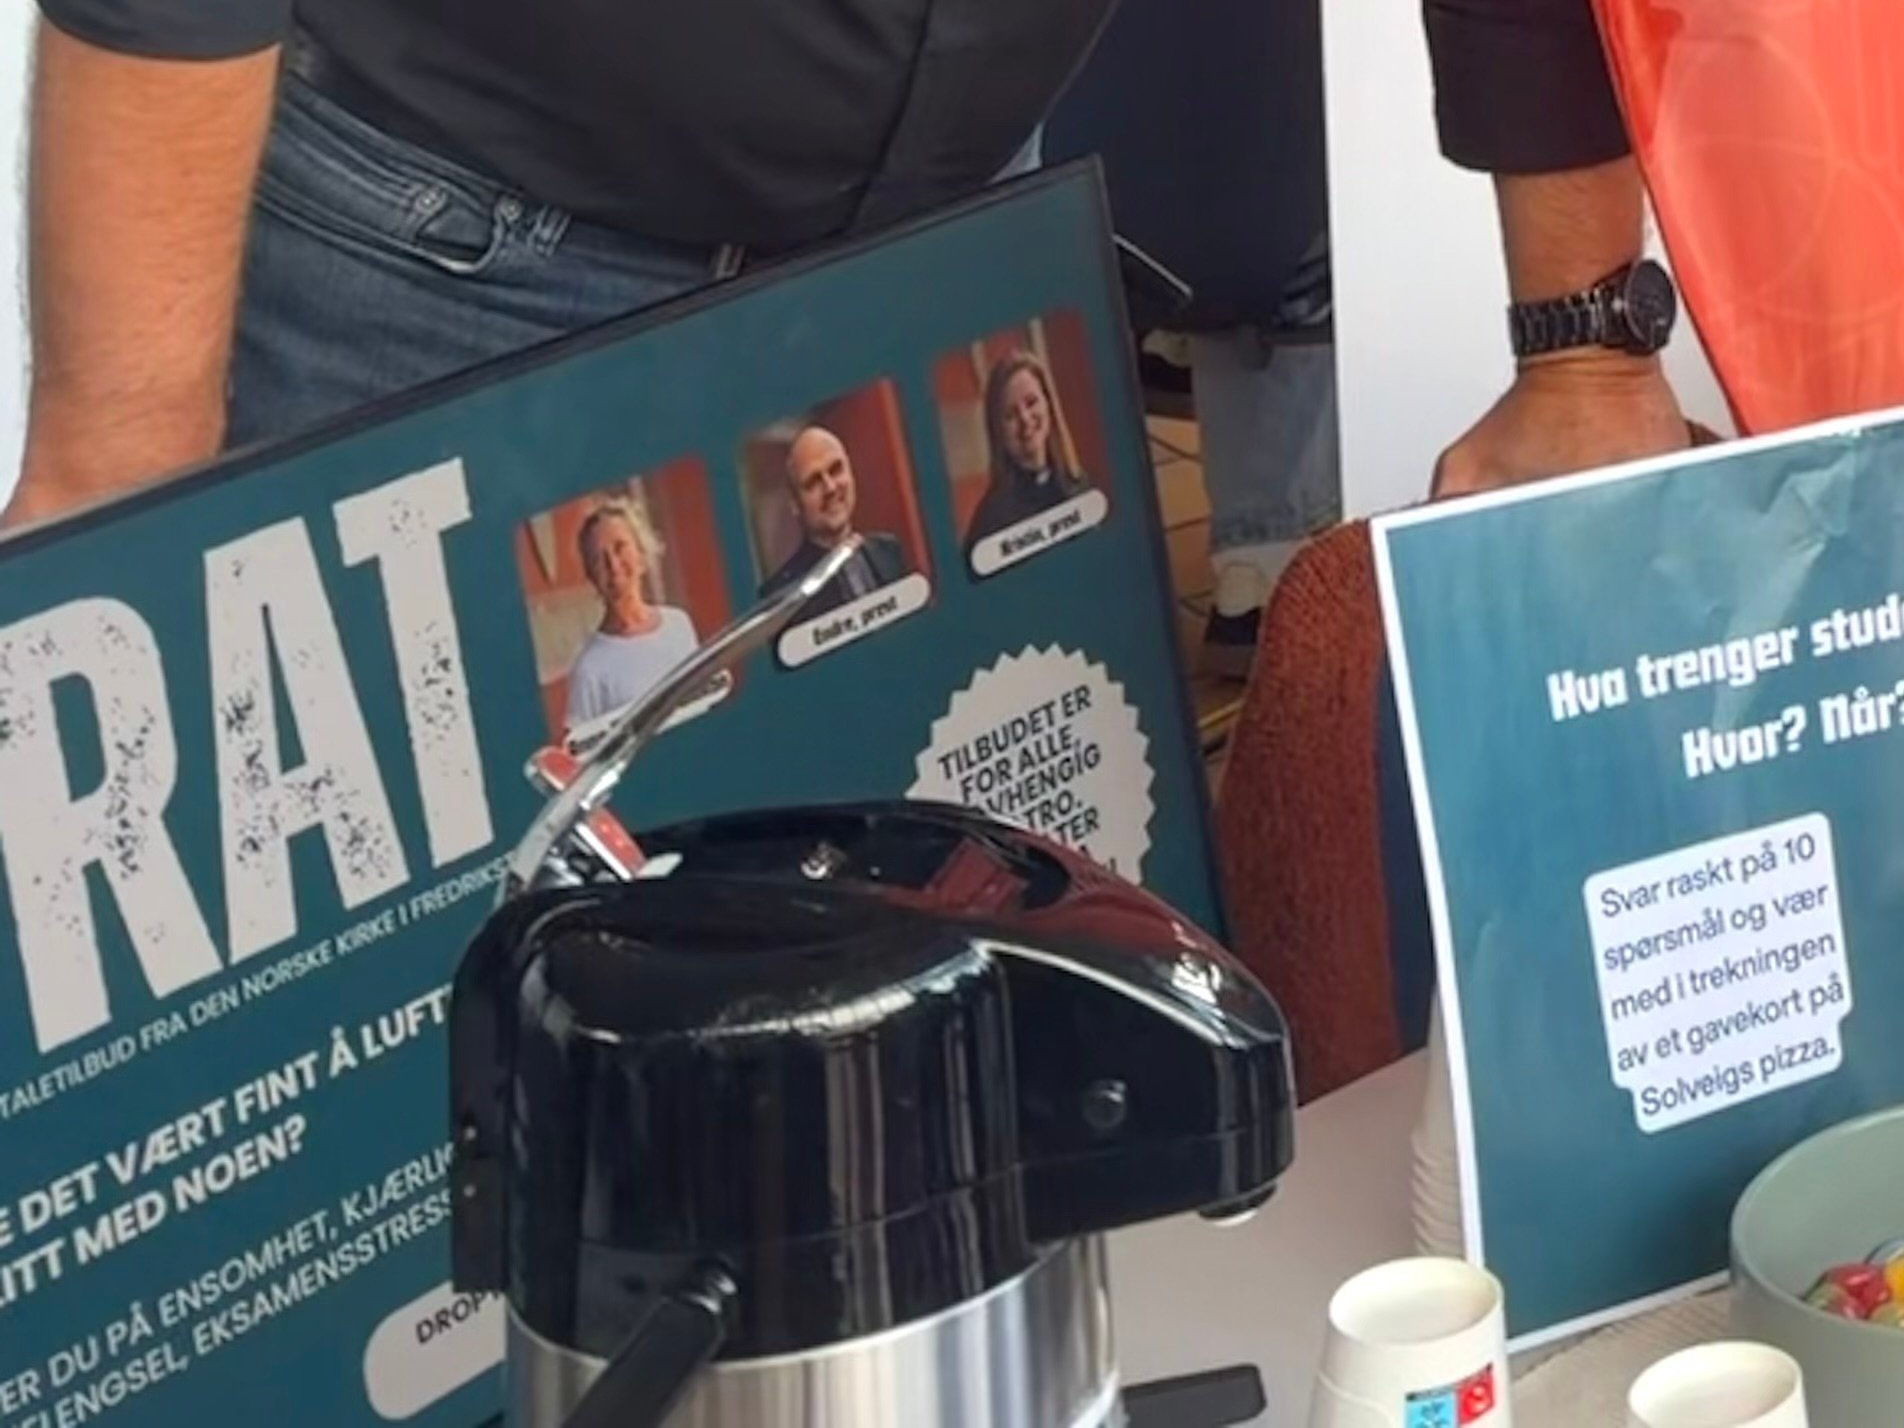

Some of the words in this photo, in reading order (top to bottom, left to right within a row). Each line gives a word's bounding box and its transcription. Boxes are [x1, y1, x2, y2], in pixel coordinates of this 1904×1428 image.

[1546, 666, 1630, 722] Hva
[1635, 625, 1800, 699] trenger
[937, 701, 1058, 780] TILBUDET
[1061, 684, 1093, 720] ER
[960, 756, 1013, 804] FOR
[1017, 723, 1082, 774] ALLE,
[1681, 704, 1807, 779] Hvor?
[985, 742, 1103, 814] VHENGIG
[1054, 806, 1101, 845] TER
[1600, 880, 1662, 919] Svar
[1666, 856, 1735, 899] raskt
[1740, 839, 1778, 884] på
[1785, 831, 1815, 865] 10
[1603, 906, 1726, 973] spørsmål
[1730, 902, 1767, 933] og
[1772, 884, 1829, 919] vær
[141, 1012, 188, 1052] FRA
[190, 988, 241, 1028] DEN
[241, 939, 333, 1003] NORSKE
[335, 909, 396, 958] KIRKE
[398, 904, 408, 926] I
[1610, 976, 1673, 1022] med
[1675, 972, 1685, 1000] i
[1689, 932, 1836, 997] trekningen
[1616, 1043, 1648, 1073] av
[1654, 1027, 1683, 1060] et
[1686, 987, 1804, 1057] gavekort
[1808, 970, 1845, 1016] på
[19, 1161, 101, 1234] DET
[105, 1098, 228, 1186] VÆRT
[234, 1052, 319, 1125] FINT
[328, 1026, 358, 1079] Å
[359, 982, 454, 1060] LUFT
[1640, 1060, 1756, 1118] Solveigs
[1758, 1035, 1837, 1084] pizza.
[72, 1190, 168, 1265] MED
[173, 1114, 307, 1214] NOEN?
[47, 1335, 101, 1388] DU
[105, 1300, 154, 1357] PÅ
[159, 1206, 340, 1326] ENSOMHET,
